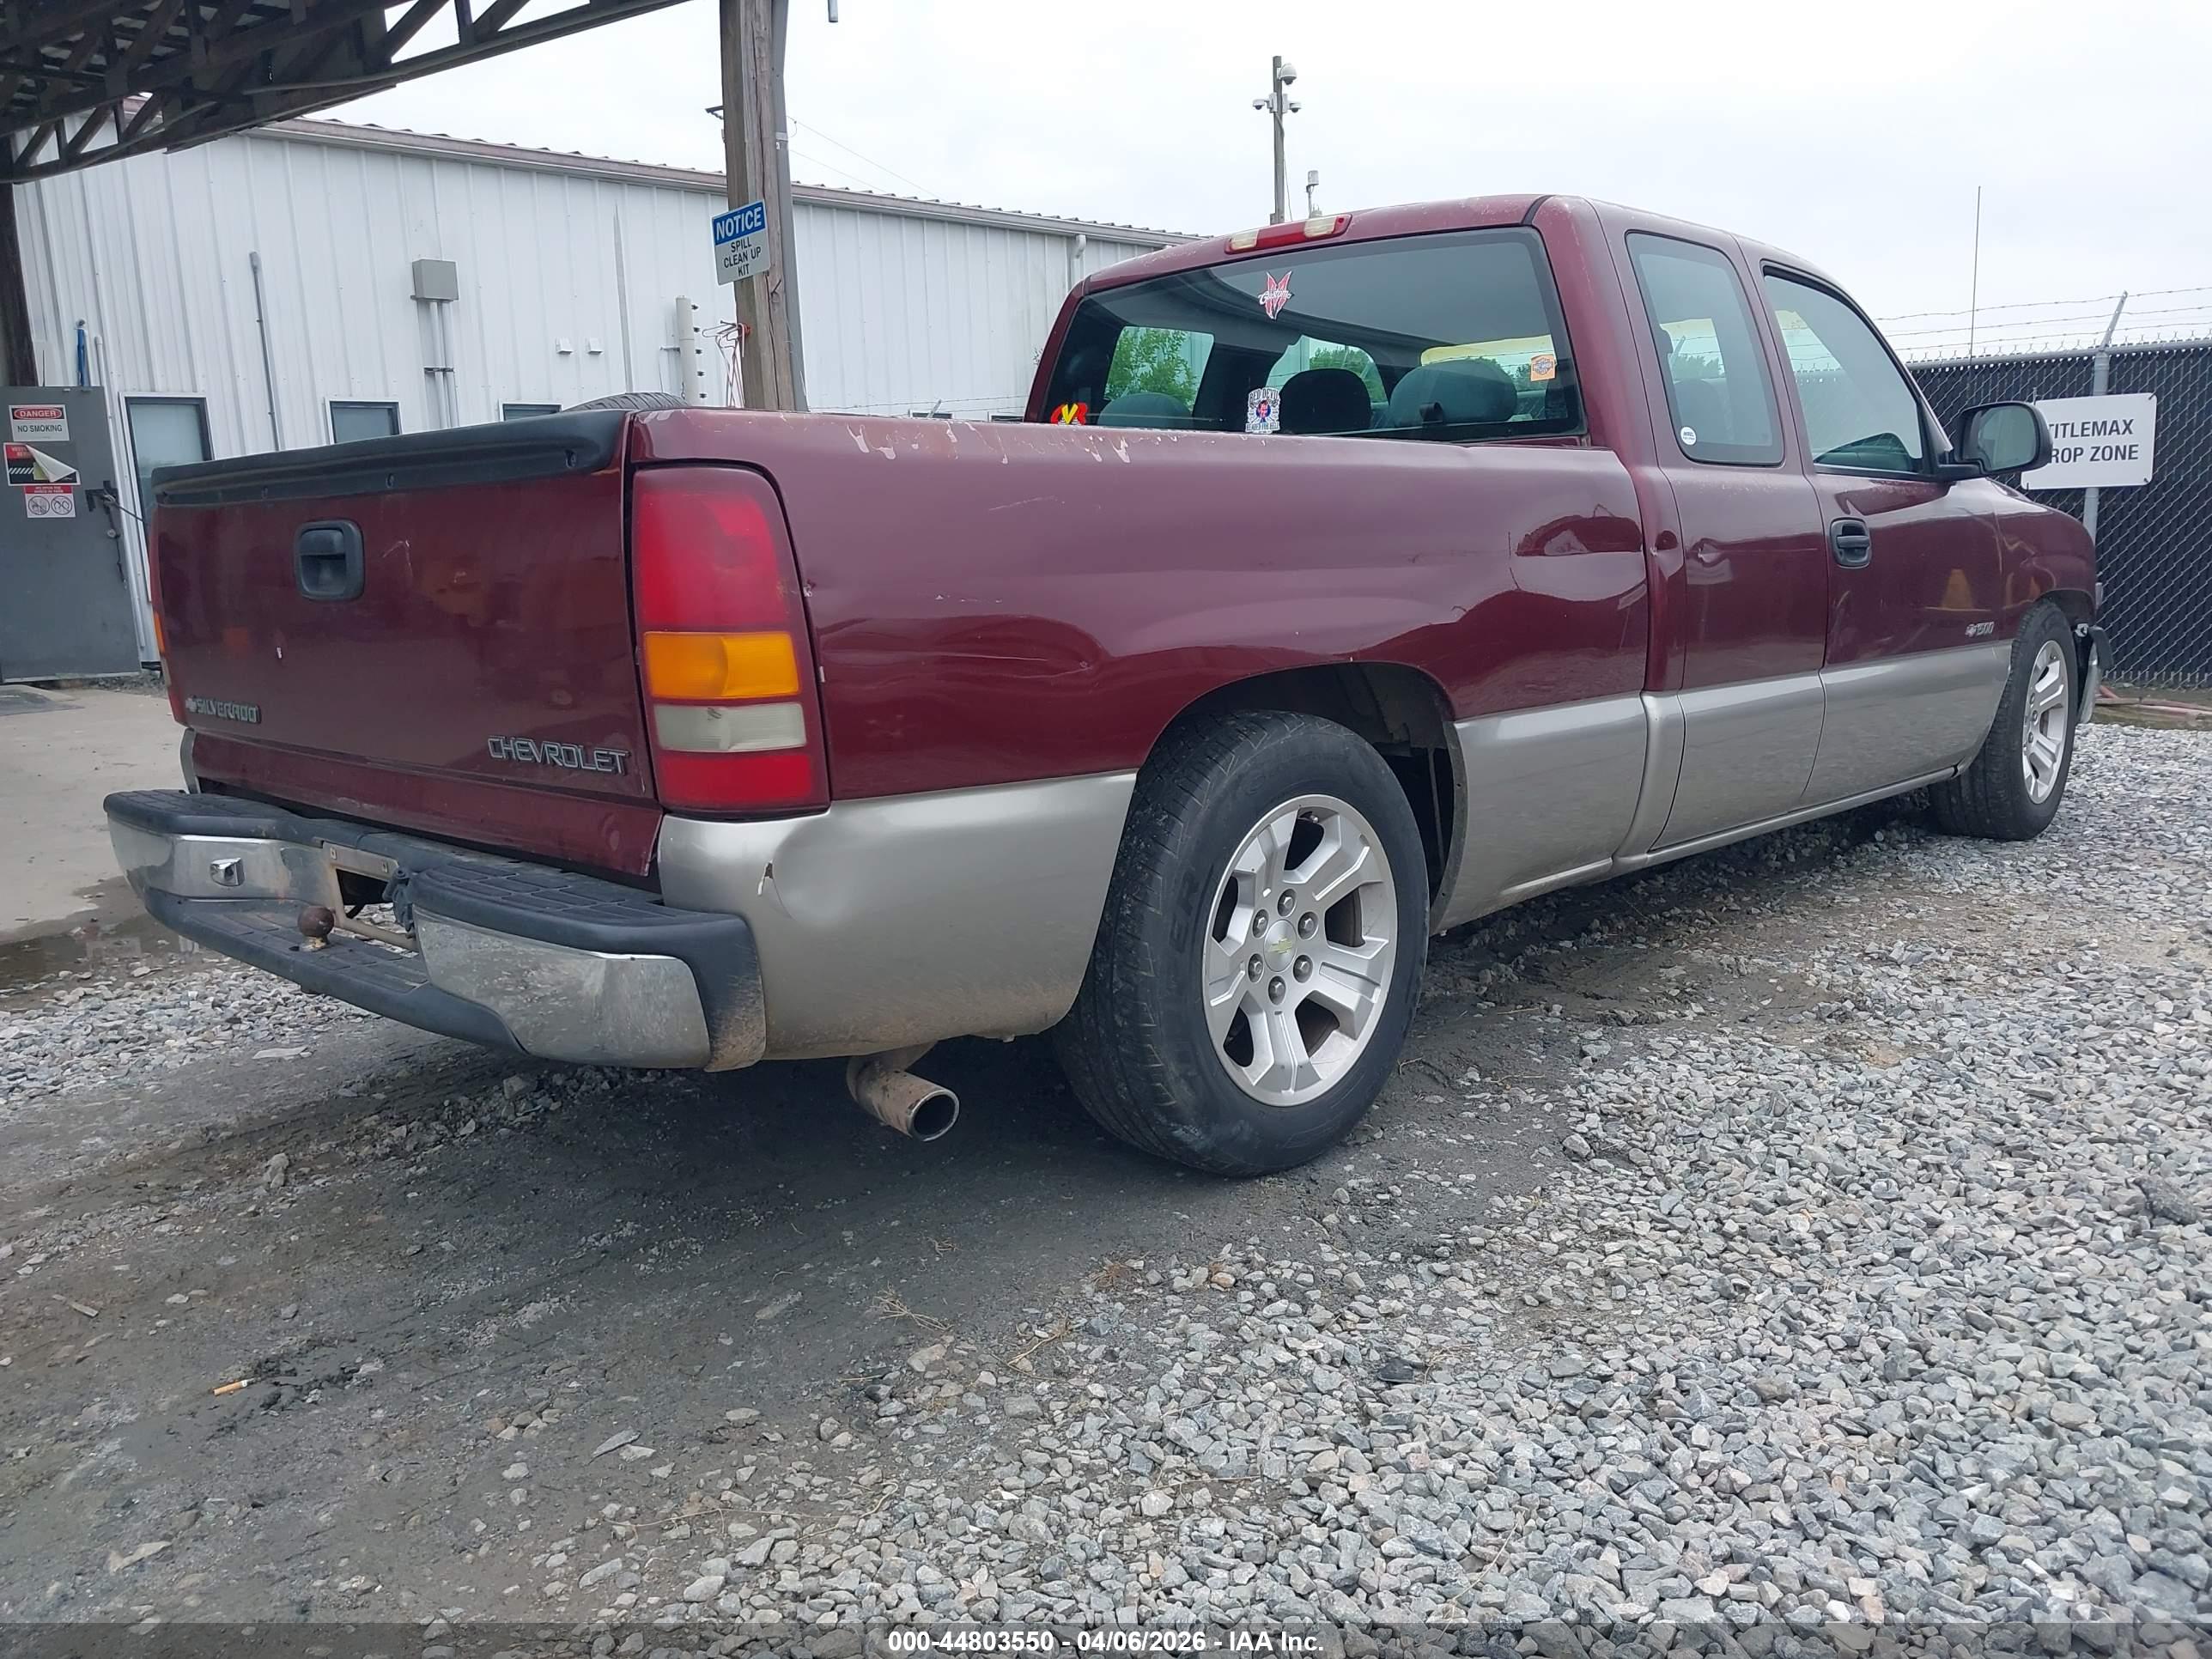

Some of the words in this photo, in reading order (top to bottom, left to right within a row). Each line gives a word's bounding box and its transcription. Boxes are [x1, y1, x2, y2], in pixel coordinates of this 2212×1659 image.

[716, 206, 763, 241] NOTICE
[731, 236, 752, 252] SPILL
[724, 250, 749, 269] CLEAN
[750, 246, 762, 259] UP
[738, 264, 750, 277] KIT
[1262, 388, 1279, 399] DEVIL
[29, 424, 63, 433] SMOKING
[2049, 418, 2134, 439] ITLEMAX
[2051, 447, 2084, 464] ROP
[2089, 444, 2139, 462] ZONE
[195, 698, 259, 723] SILVERADO
[487, 734, 632, 775] CHEVROLET
